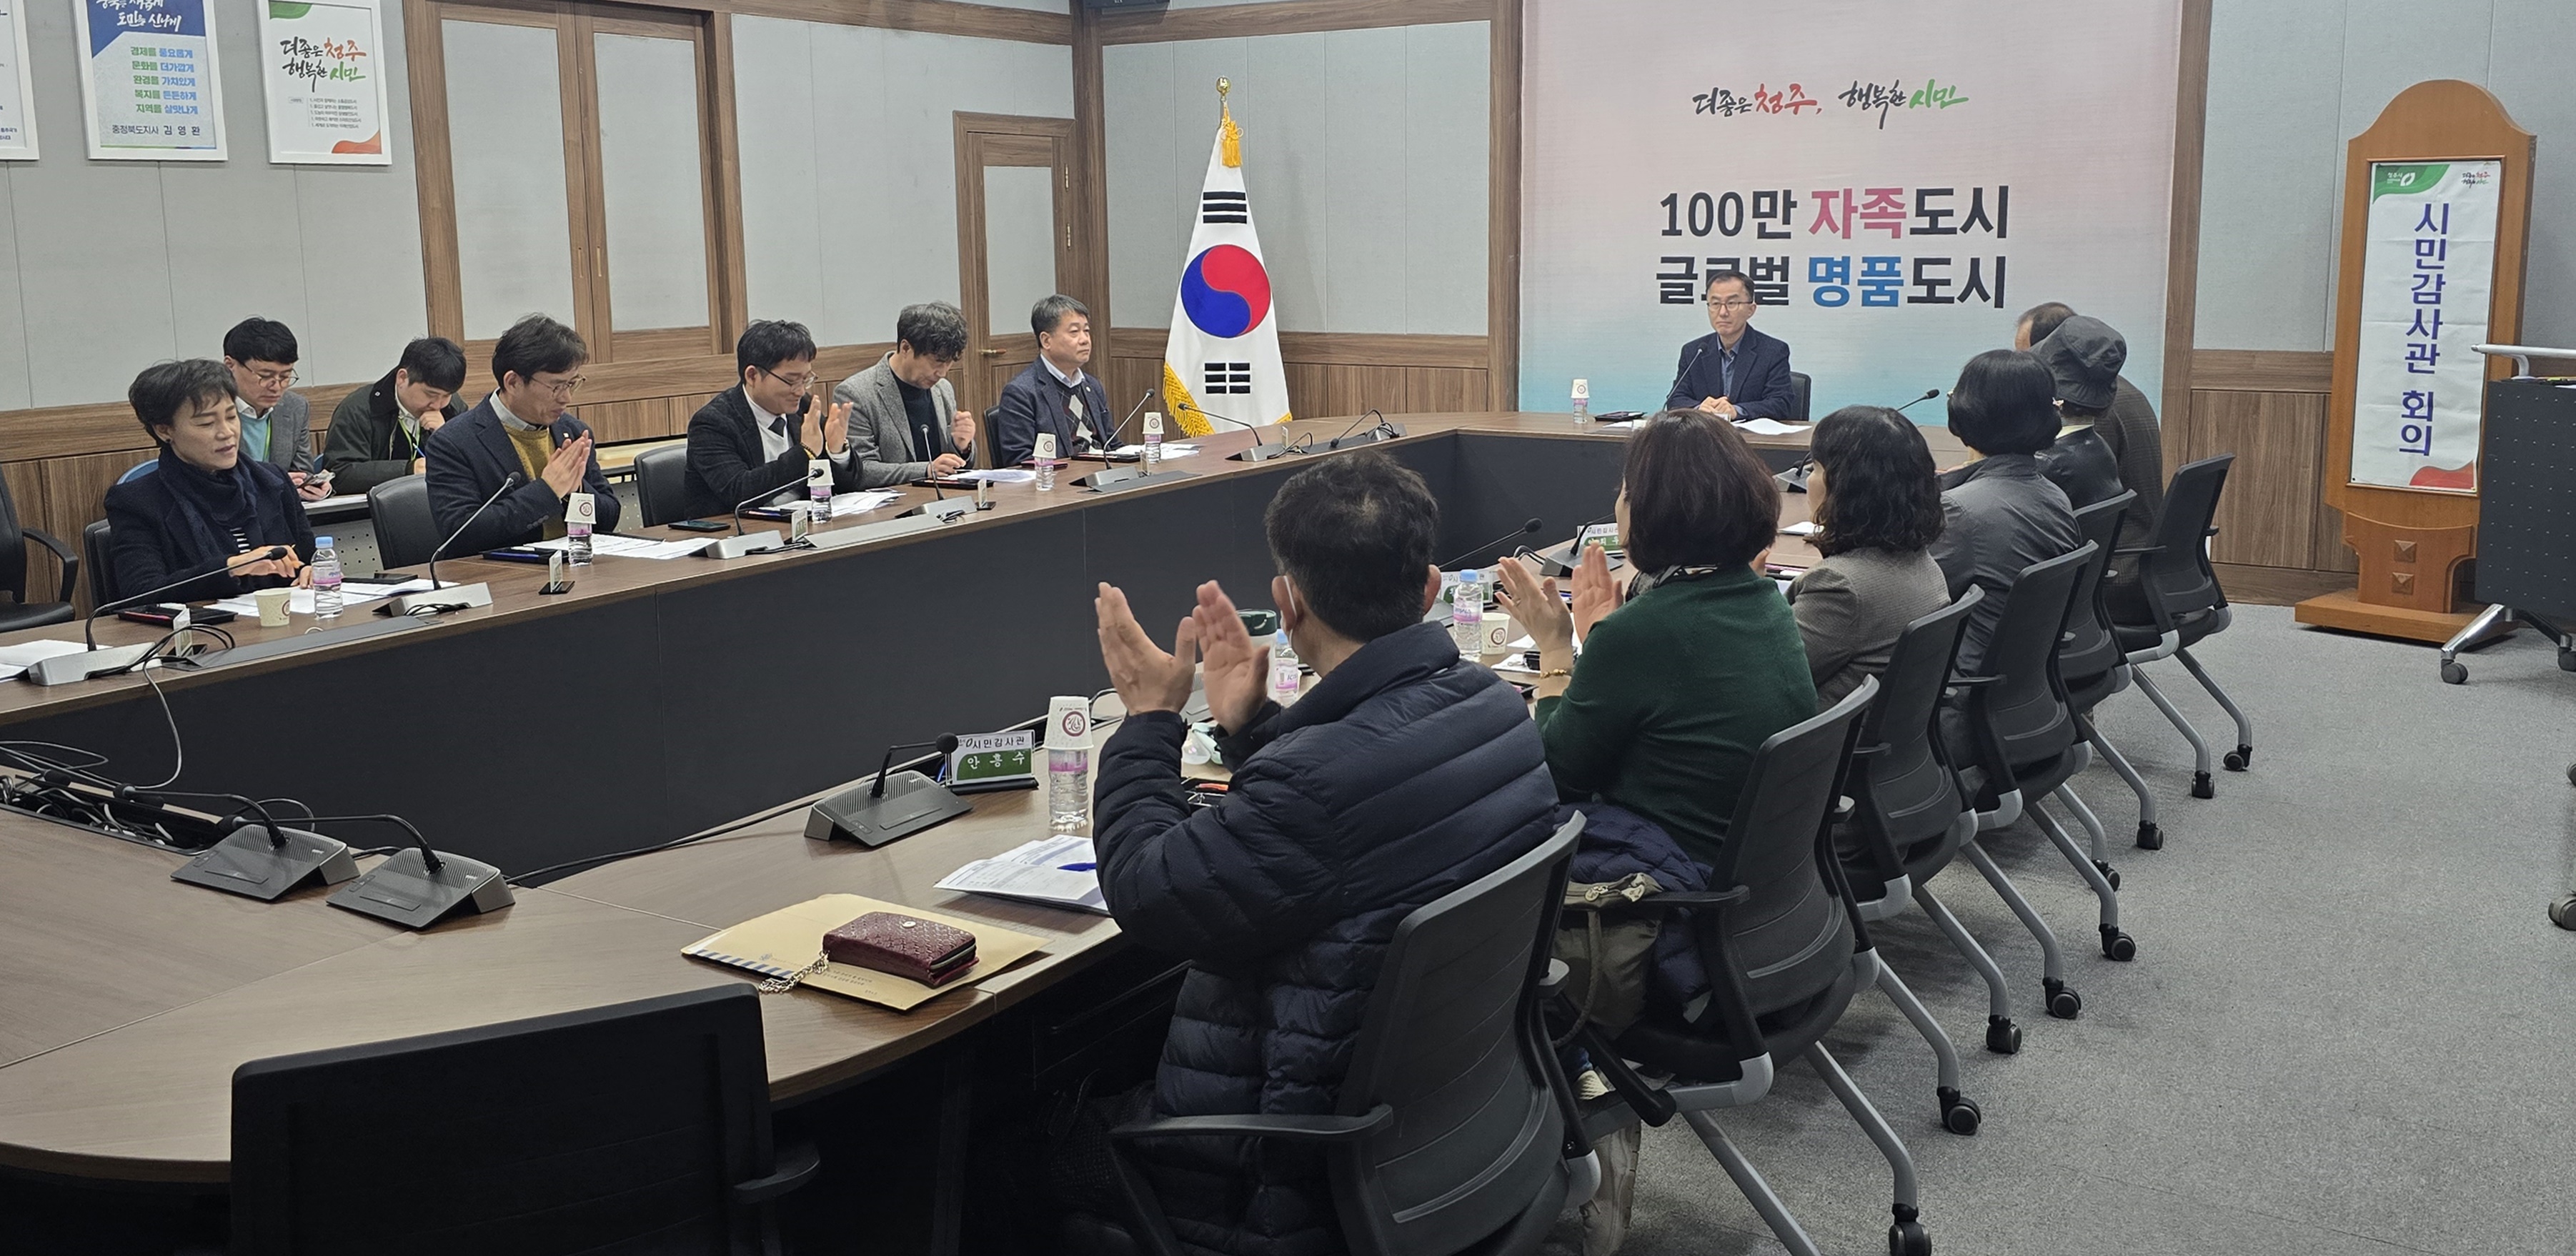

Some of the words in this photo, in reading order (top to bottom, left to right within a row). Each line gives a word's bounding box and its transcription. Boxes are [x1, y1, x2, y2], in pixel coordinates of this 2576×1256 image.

[148, 13, 181, 31] 신나게
[161, 76, 196, 87] 가치있게
[329, 61, 367, 82] 시민
[134, 89, 161, 100] 복지를
[163, 91, 197, 101] 든든하게
[1909, 79, 1969, 109] 시민
[112, 124, 159, 135] 충청북도지사
[1659, 189, 1798, 239] 100만
[1808, 185, 2009, 239] 자족도시
[1807, 255, 2006, 309] 명품도시
[2405, 202, 2450, 375] 시민감사관
[2399, 390, 2435, 457] 회의
[972, 736, 1025, 749] 시민감사관
